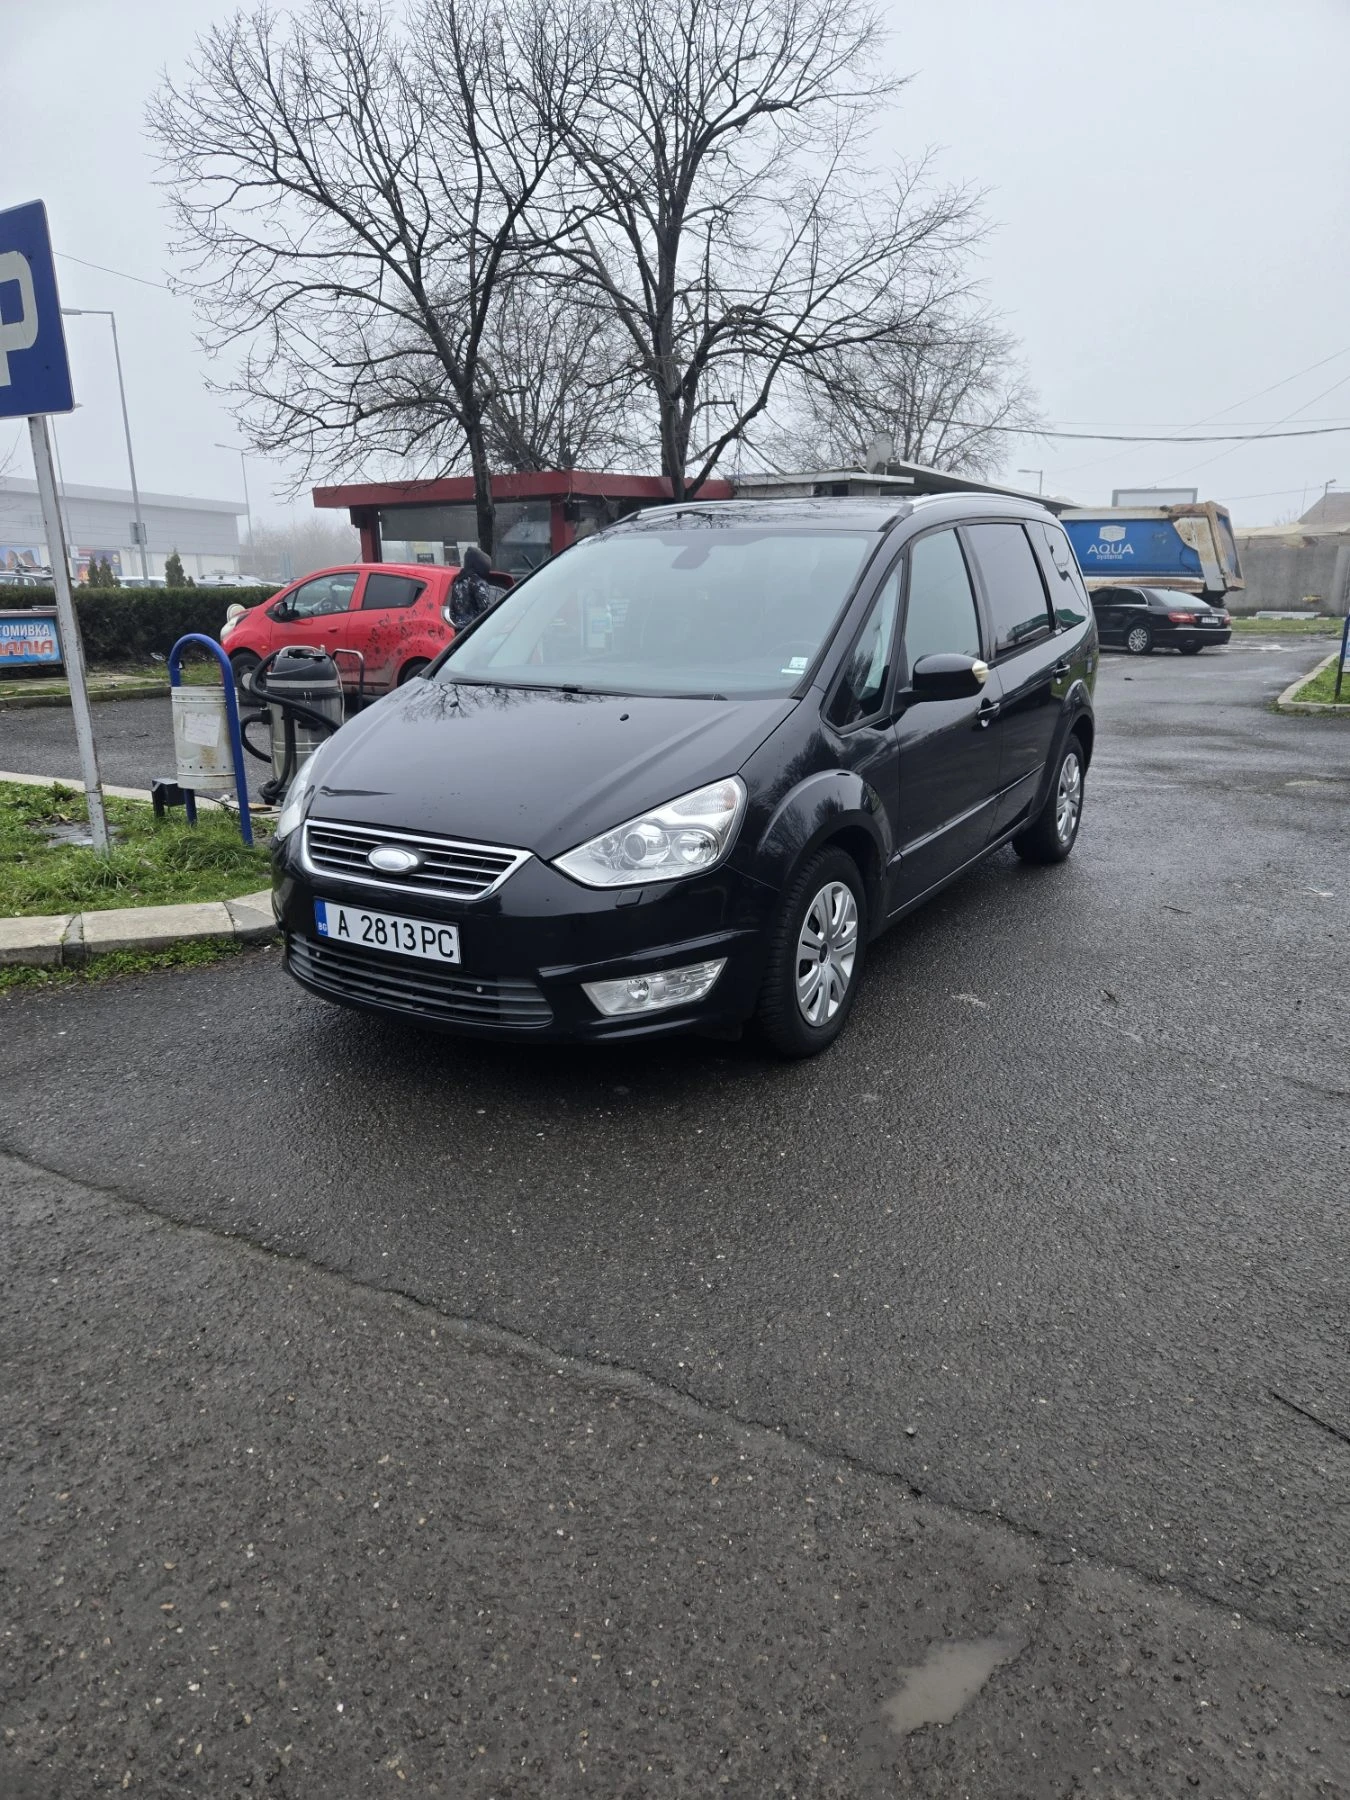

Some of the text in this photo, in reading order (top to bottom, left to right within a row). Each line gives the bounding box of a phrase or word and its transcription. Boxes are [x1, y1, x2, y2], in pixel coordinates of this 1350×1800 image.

[0, 250, 39, 386] P
[1087, 543, 1134, 554] AQUA
[318, 922, 328, 932] BG
[338, 910, 350, 938] A
